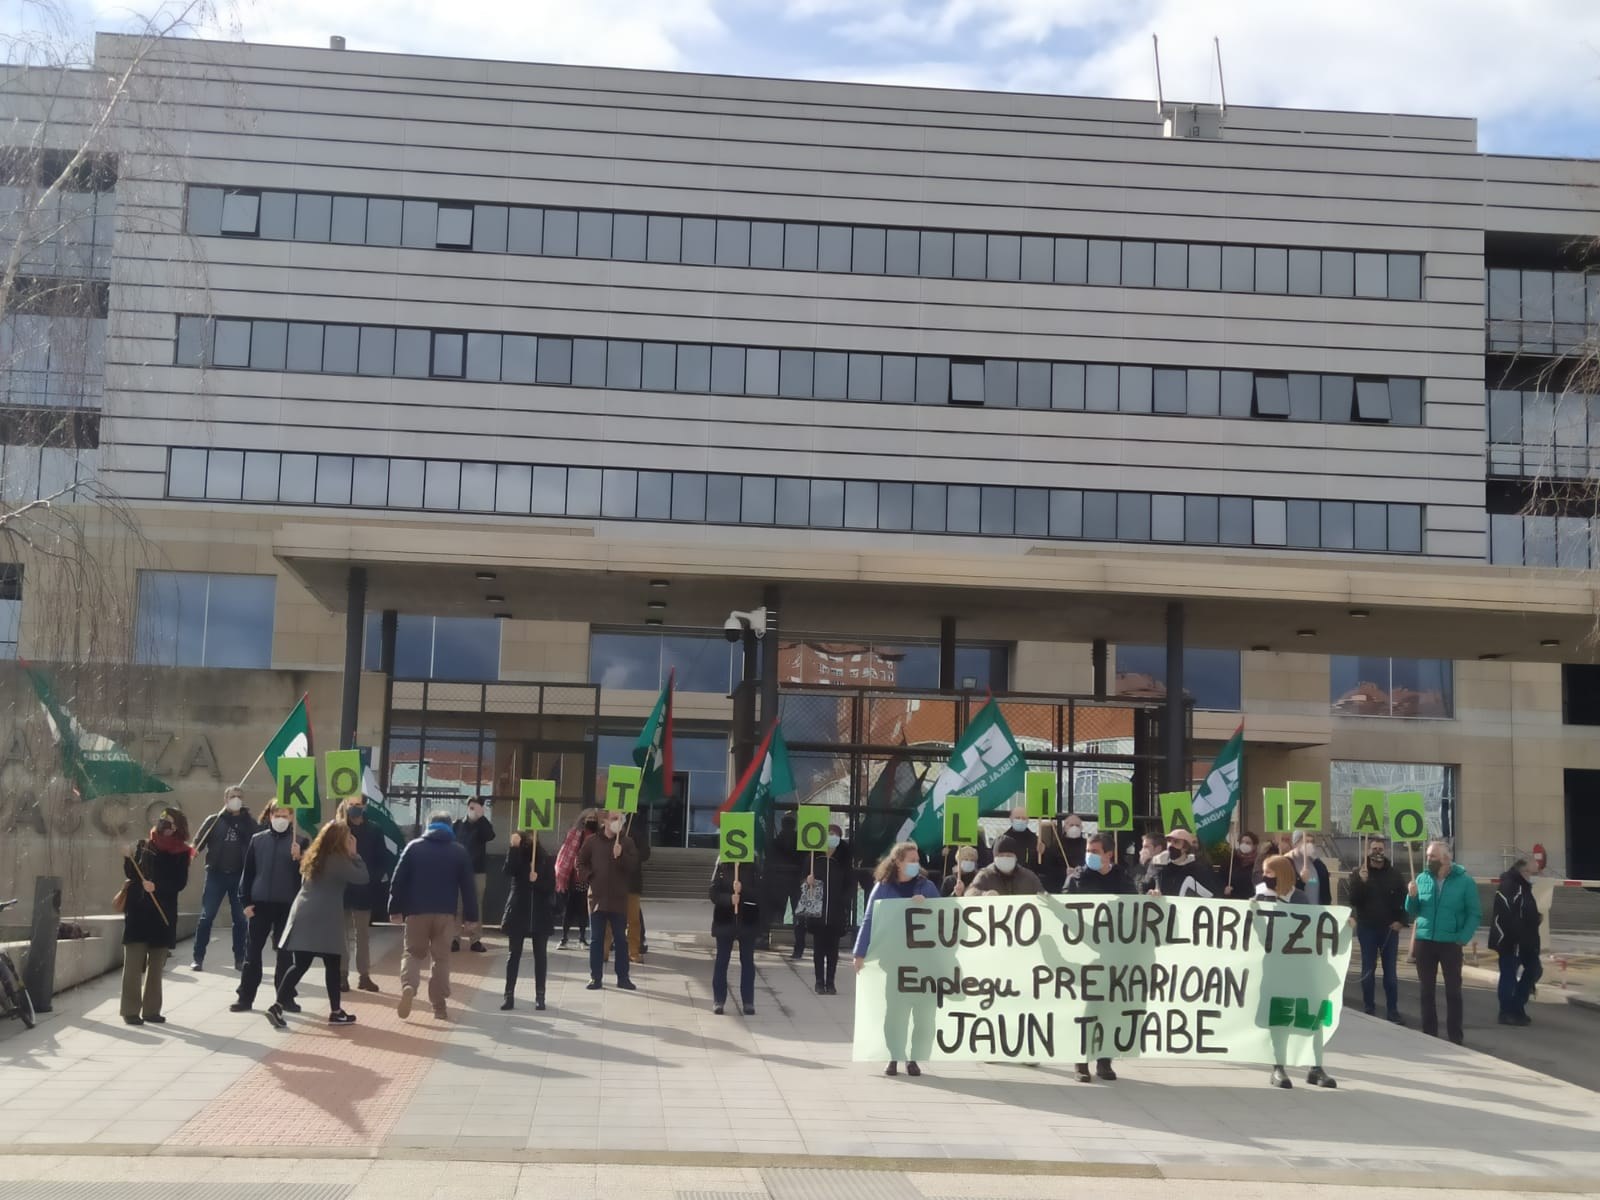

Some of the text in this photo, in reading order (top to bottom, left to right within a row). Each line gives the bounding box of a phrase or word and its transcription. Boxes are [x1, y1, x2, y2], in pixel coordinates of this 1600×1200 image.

[283, 774, 308, 804] K
[331, 767, 356, 800] O
[611, 781, 635, 809] T
[525, 796, 552, 831] N
[1041, 787, 1049, 815] I
[1104, 799, 1131, 829] D
[1294, 799, 1317, 828] Z
[952, 813, 972, 843] L
[1170, 808, 1193, 833] A
[1276, 803, 1284, 830] I
[1357, 804, 1381, 830] A
[1393, 808, 1423, 839] O
[724, 829, 750, 860] S
[802, 822, 826, 852] O
[905, 900, 1341, 956] EUSKO JAURLARITZA
[897, 963, 1248, 1009] Enplegu PREKARIOAN
[936, 1009, 1229, 1058] JAUN TA JABE
